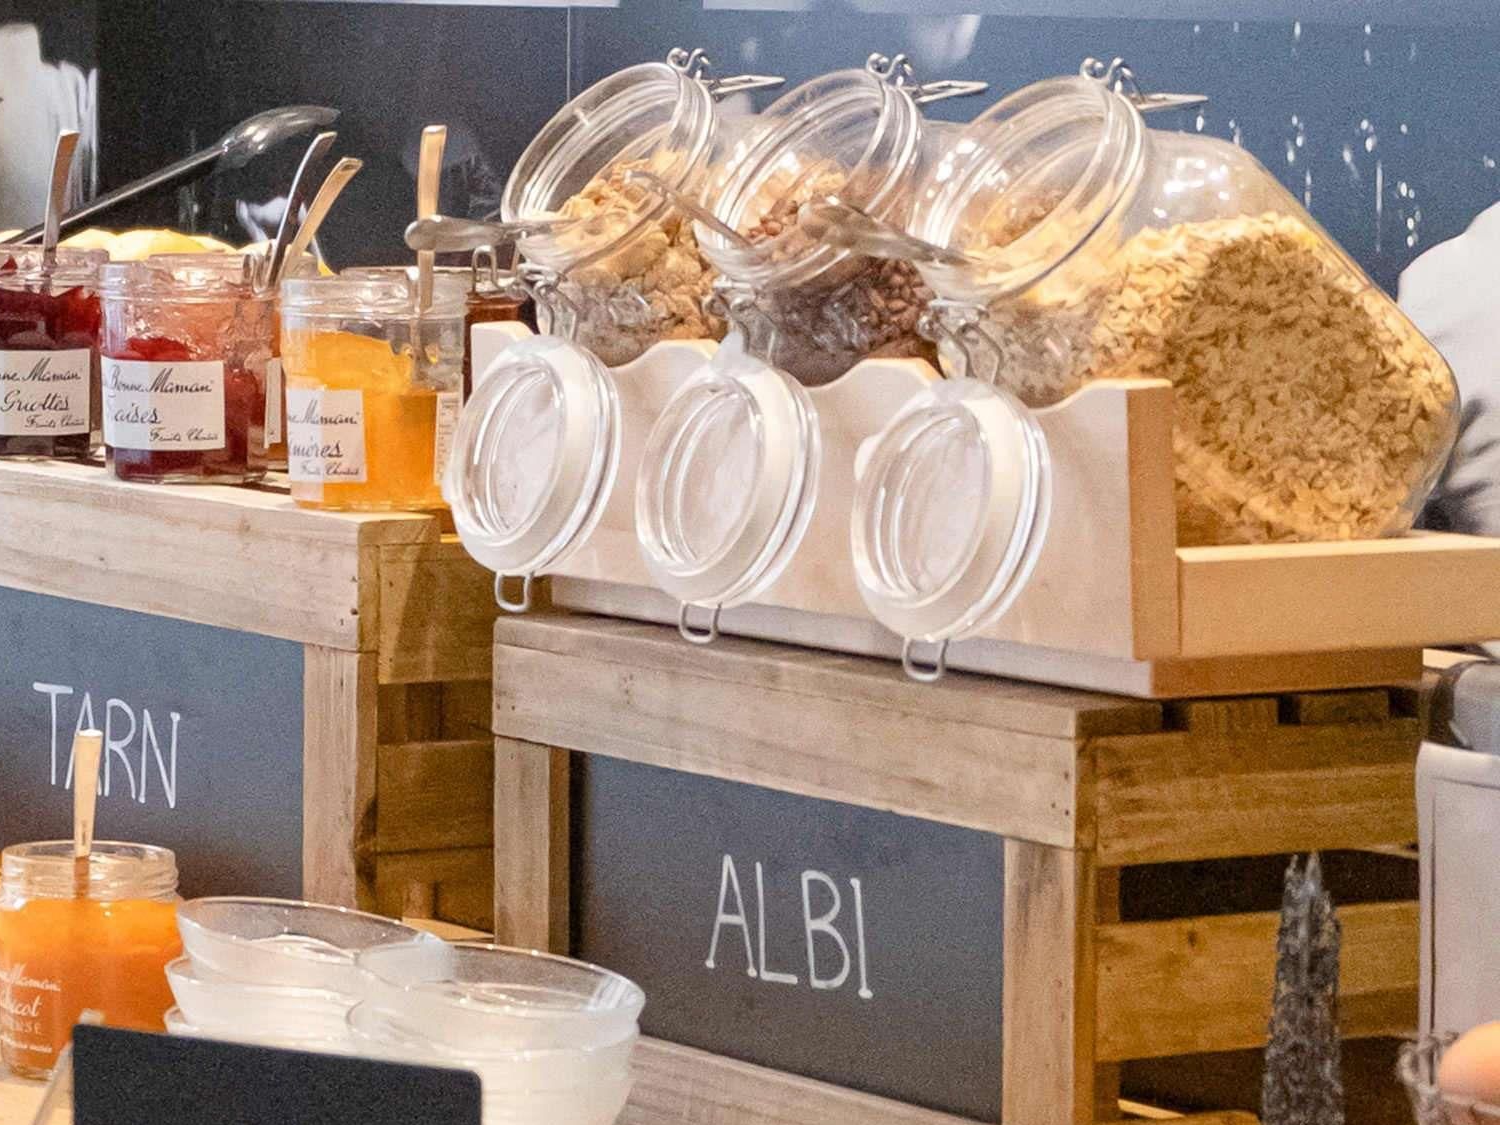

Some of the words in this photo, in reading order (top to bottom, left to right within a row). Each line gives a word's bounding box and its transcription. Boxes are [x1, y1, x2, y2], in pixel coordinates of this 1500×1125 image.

[21, 356, 81, 382] Maman
[142, 367, 213, 393] Maman
[0, 389, 70, 412] Griottes
[299, 399, 359, 425] Maman
[33, 682, 180, 808] TARN
[705, 854, 873, 999] ALBI
